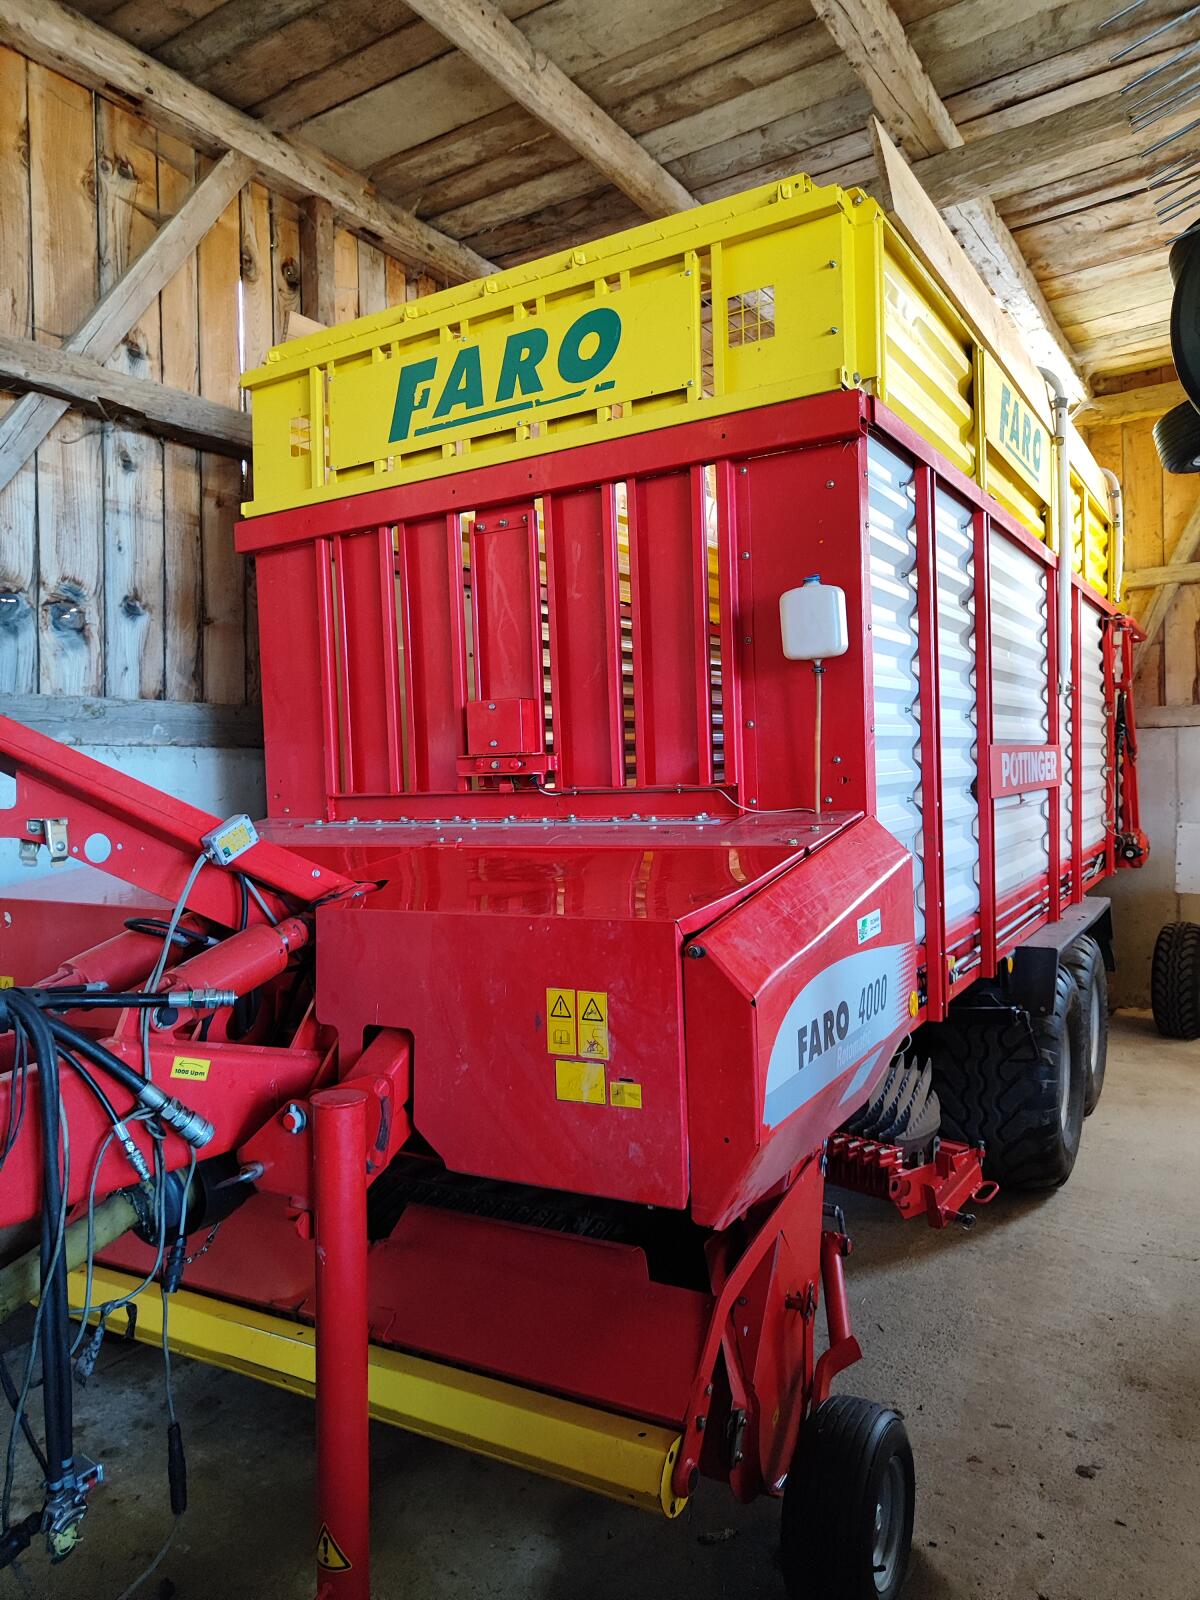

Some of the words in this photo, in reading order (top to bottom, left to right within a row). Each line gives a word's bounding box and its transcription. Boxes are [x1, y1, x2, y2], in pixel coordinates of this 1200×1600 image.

[388, 307, 622, 443] FARO
[999, 382, 1041, 472] FARO
[797, 1000, 849, 1071] FARO
[858, 974, 887, 1025] 4000
